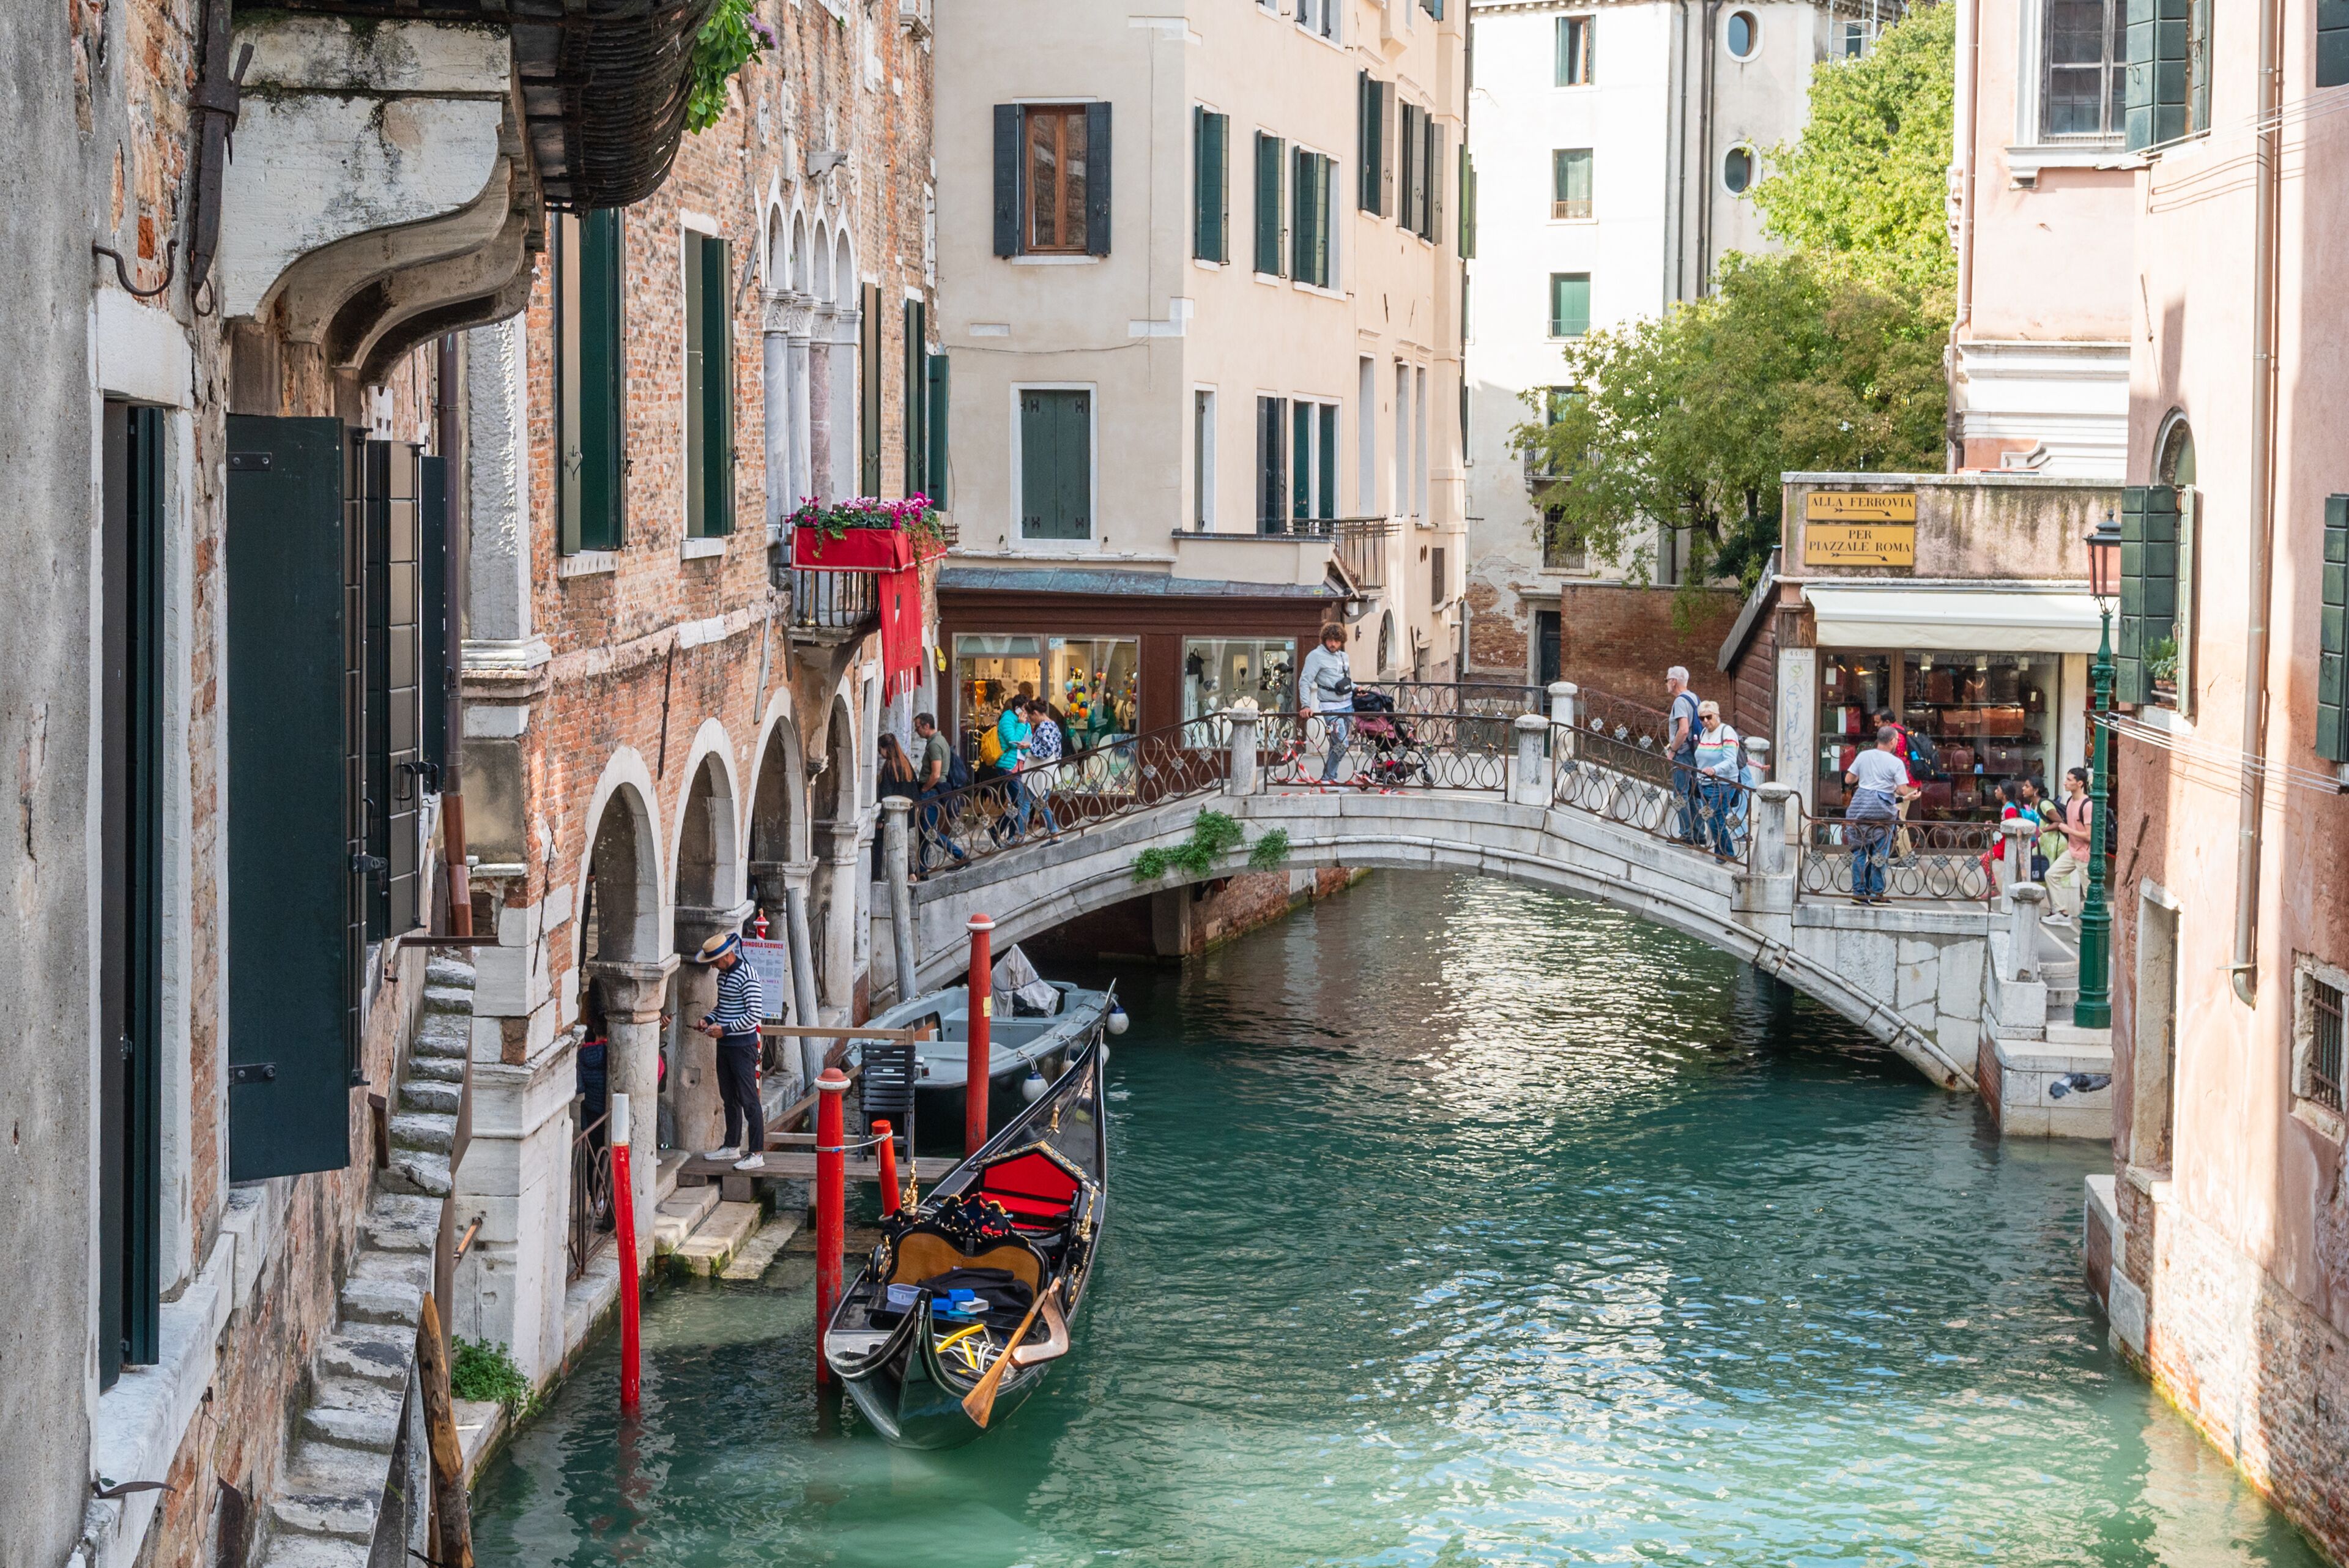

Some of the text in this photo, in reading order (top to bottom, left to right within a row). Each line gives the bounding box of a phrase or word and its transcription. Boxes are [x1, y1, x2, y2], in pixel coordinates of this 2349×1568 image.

[1811, 497, 1913, 508] ALLA FERROVIA
[1849, 529, 1872, 540] PER
[1809, 541, 1910, 552] PIAZZALE ROMA
